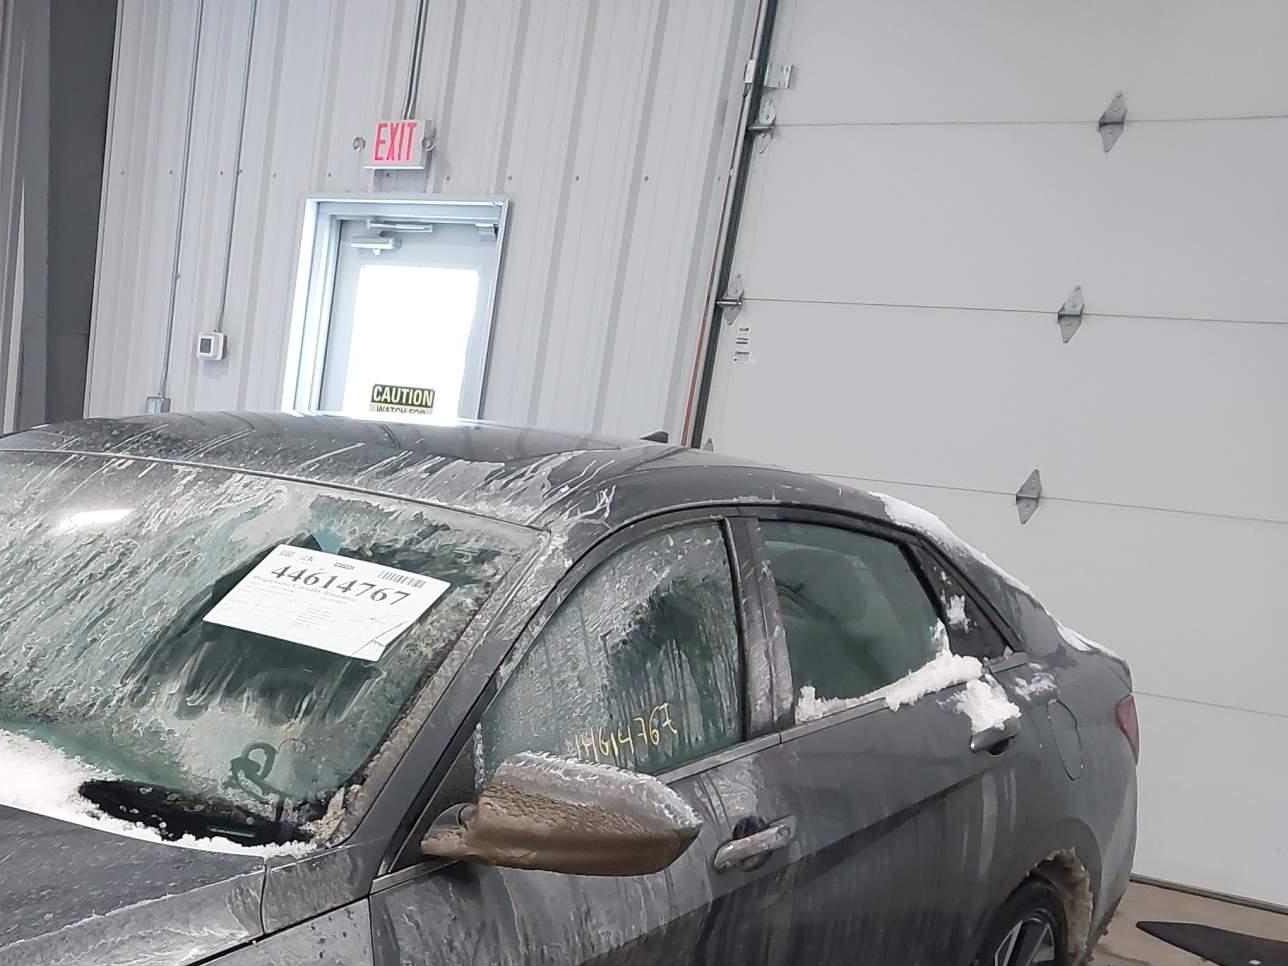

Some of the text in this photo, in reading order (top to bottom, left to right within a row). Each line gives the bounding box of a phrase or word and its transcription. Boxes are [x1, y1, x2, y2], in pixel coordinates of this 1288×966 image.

[375, 122, 417, 161] EXIT
[373, 385, 434, 407] CAUTION
[270, 565, 411, 606] 44614767
